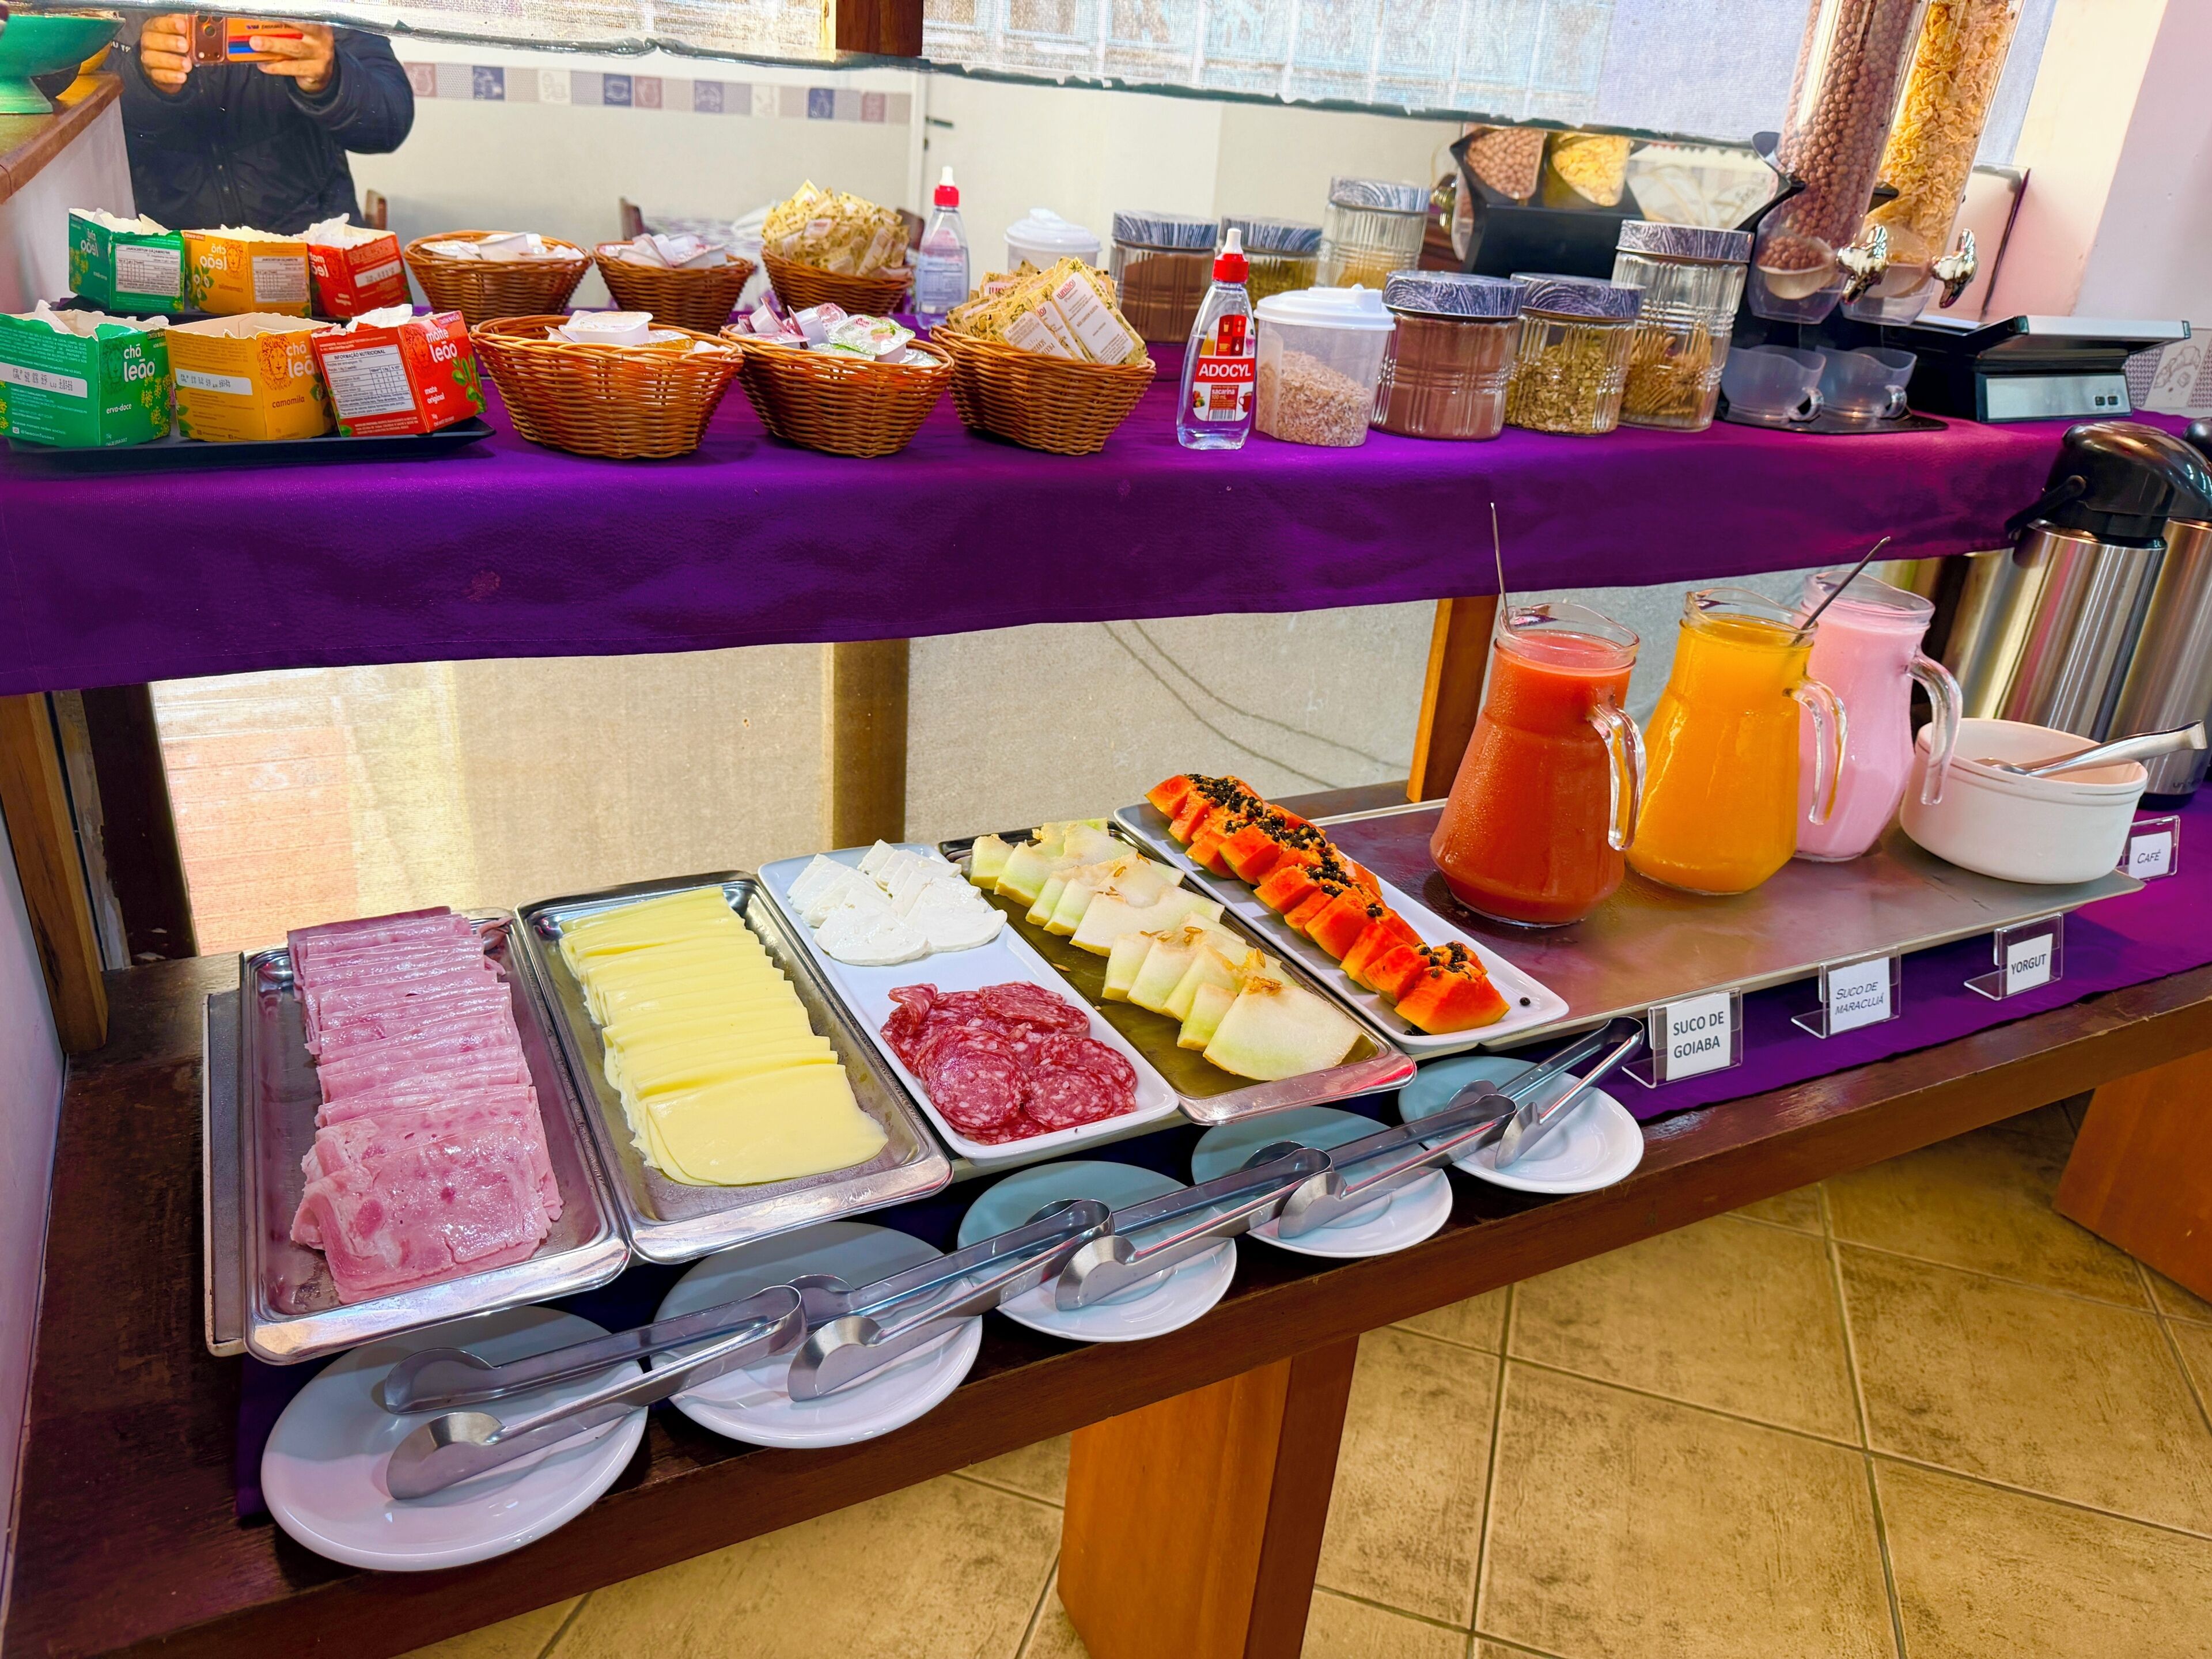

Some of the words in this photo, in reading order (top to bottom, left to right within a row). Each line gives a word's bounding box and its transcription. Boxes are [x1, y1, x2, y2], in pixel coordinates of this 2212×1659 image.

[1058, 279, 1075, 299] união
[1198, 363, 1251, 377] ADOCYL
[424, 385, 438, 395] mate
[427, 392, 446, 404] original
[106, 403, 132, 414] erva-doce
[272, 395, 305, 408] camomila
[2137, 849, 2162, 864] CAFÉ
[2011, 953, 2047, 975] YORGUT
[1835, 985, 1864, 1000] SUCO
[1865, 981, 1879, 993] DE
[1834, 992, 1884, 1016] MARACUJÁ
[1673, 1016, 1706, 1036] SUCO
[1709, 1011, 1724, 1027] DE
[1673, 1035, 1721, 1059] GOIABA
